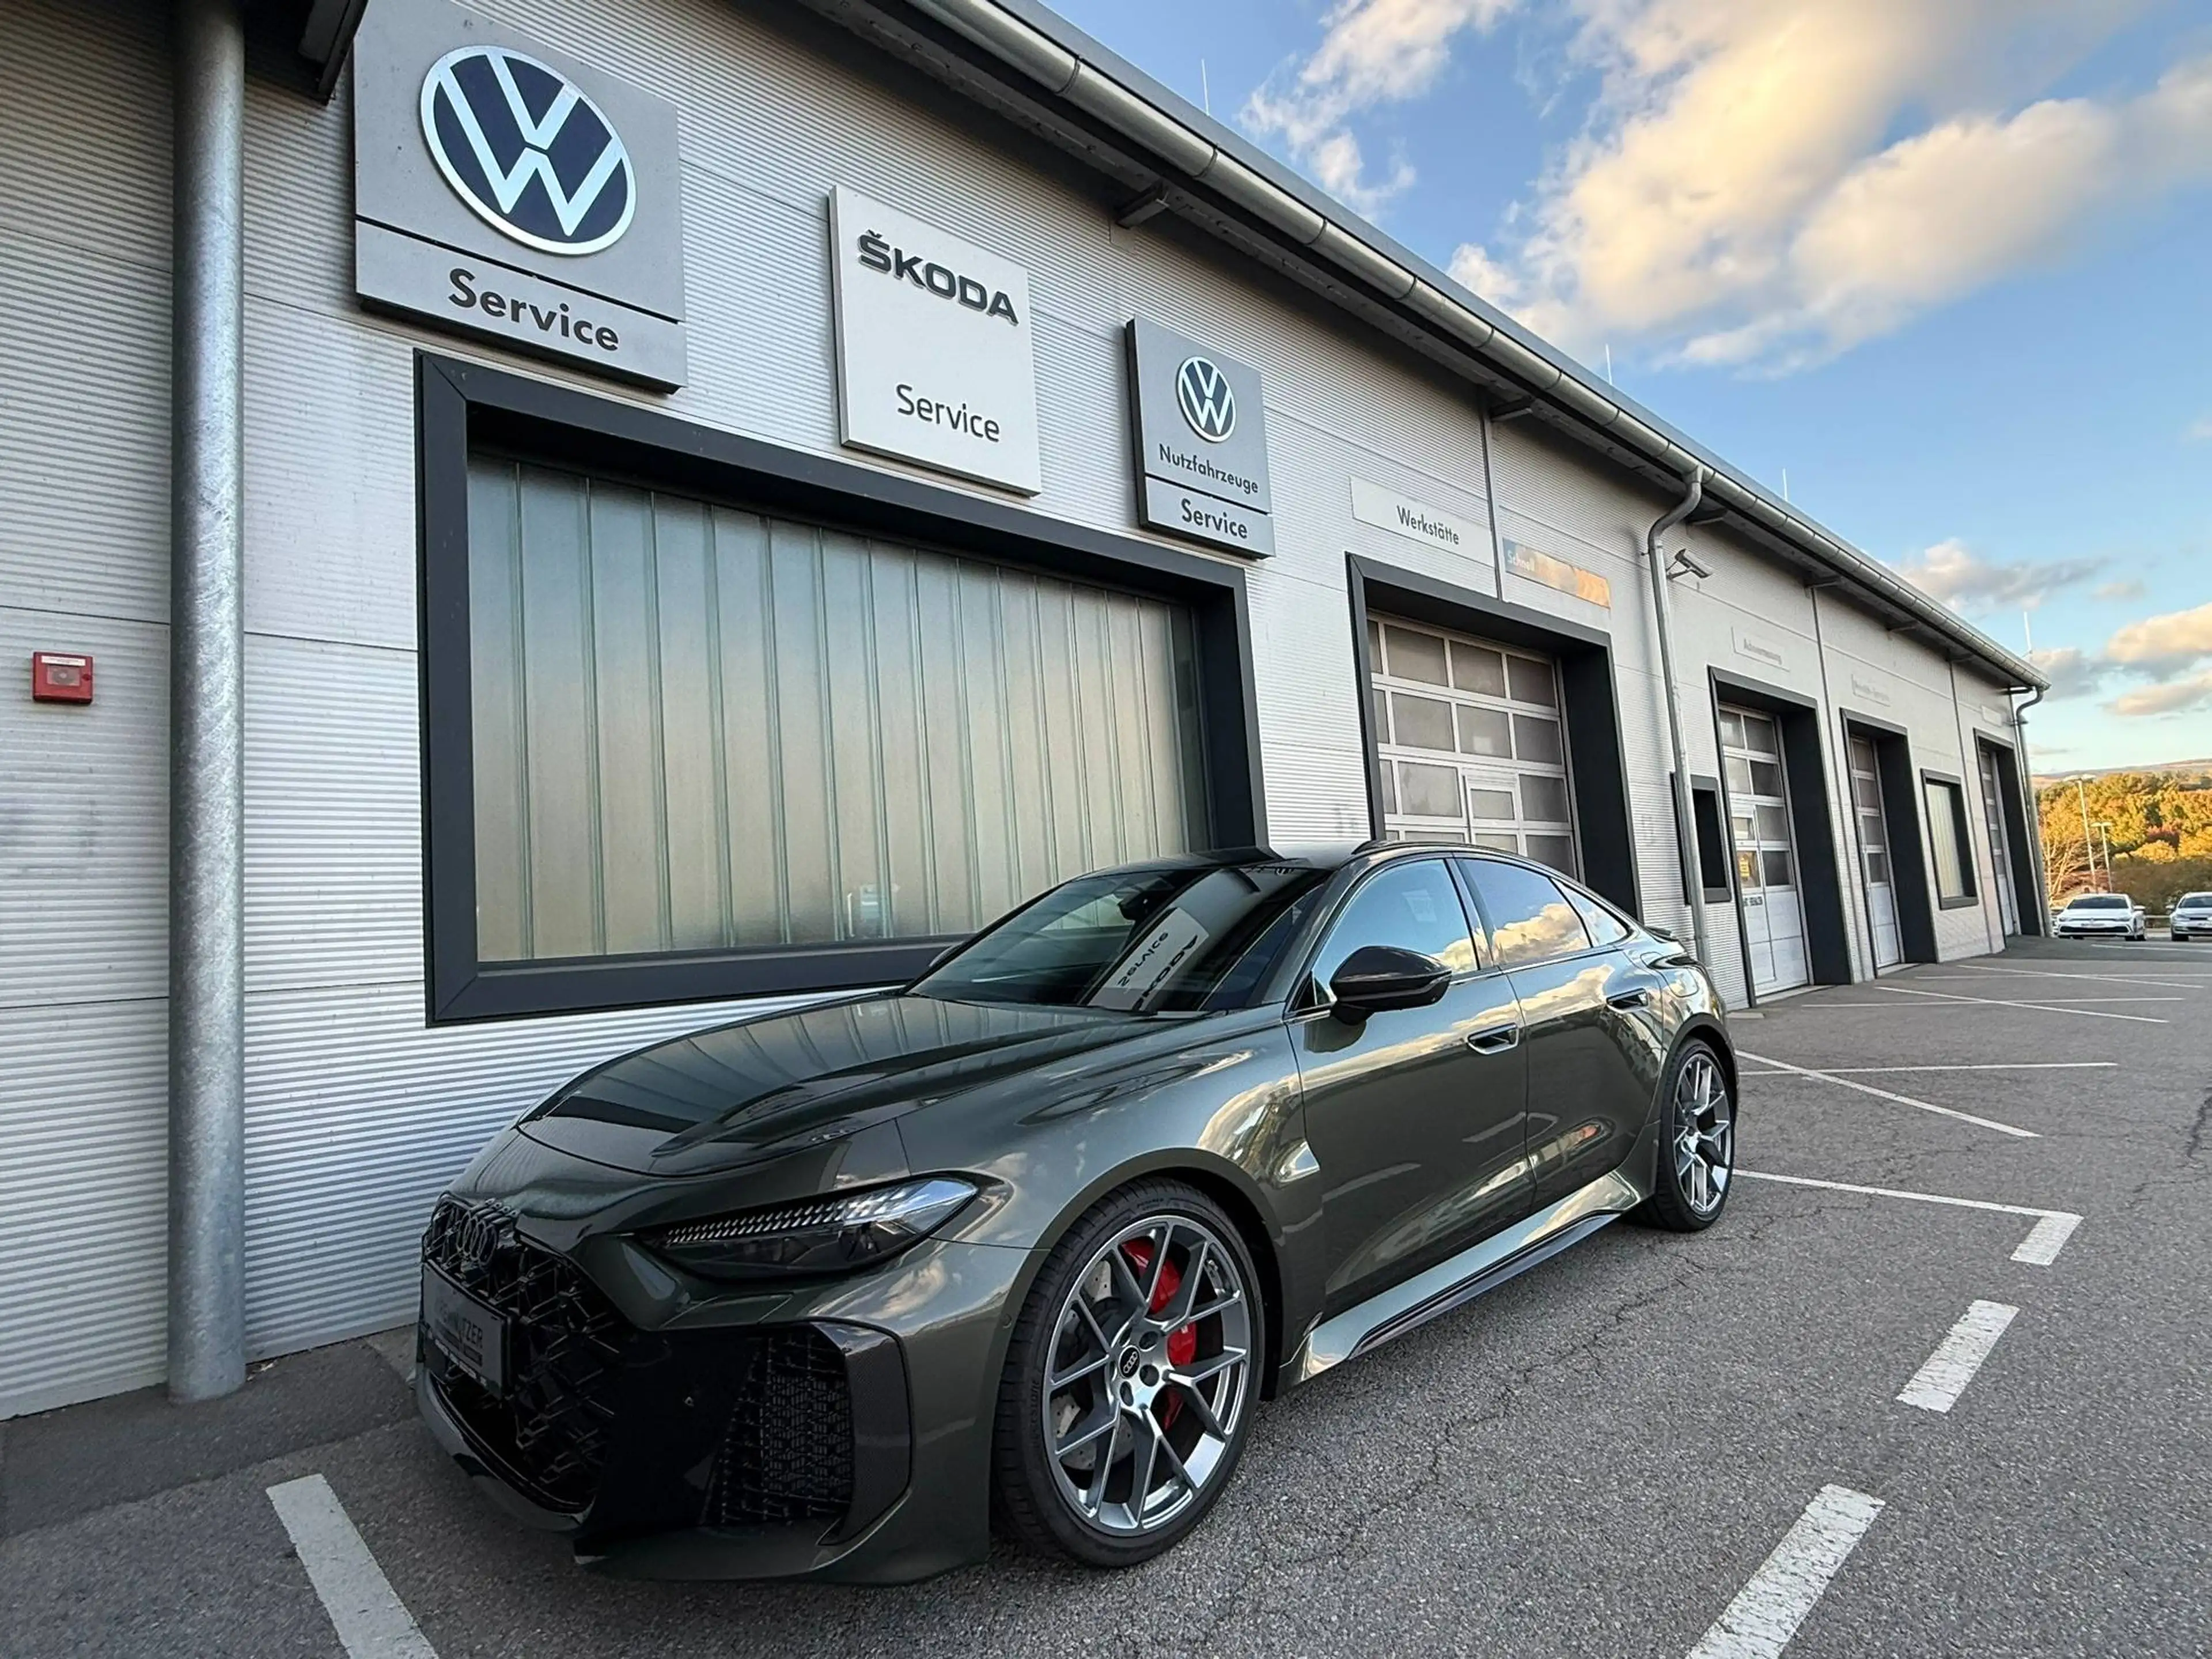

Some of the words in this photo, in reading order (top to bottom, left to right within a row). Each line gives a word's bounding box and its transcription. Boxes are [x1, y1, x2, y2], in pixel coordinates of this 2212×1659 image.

[432, 50, 630, 238] VW
[858, 229, 1019, 326] ŠKODA
[448, 267, 620, 351] Service
[895, 384, 1000, 442] Service
[1158, 444, 1259, 494] Nutzfahrzeuge
[1181, 498, 1248, 539] Service
[1396, 505, 1460, 545] Werkstätte
